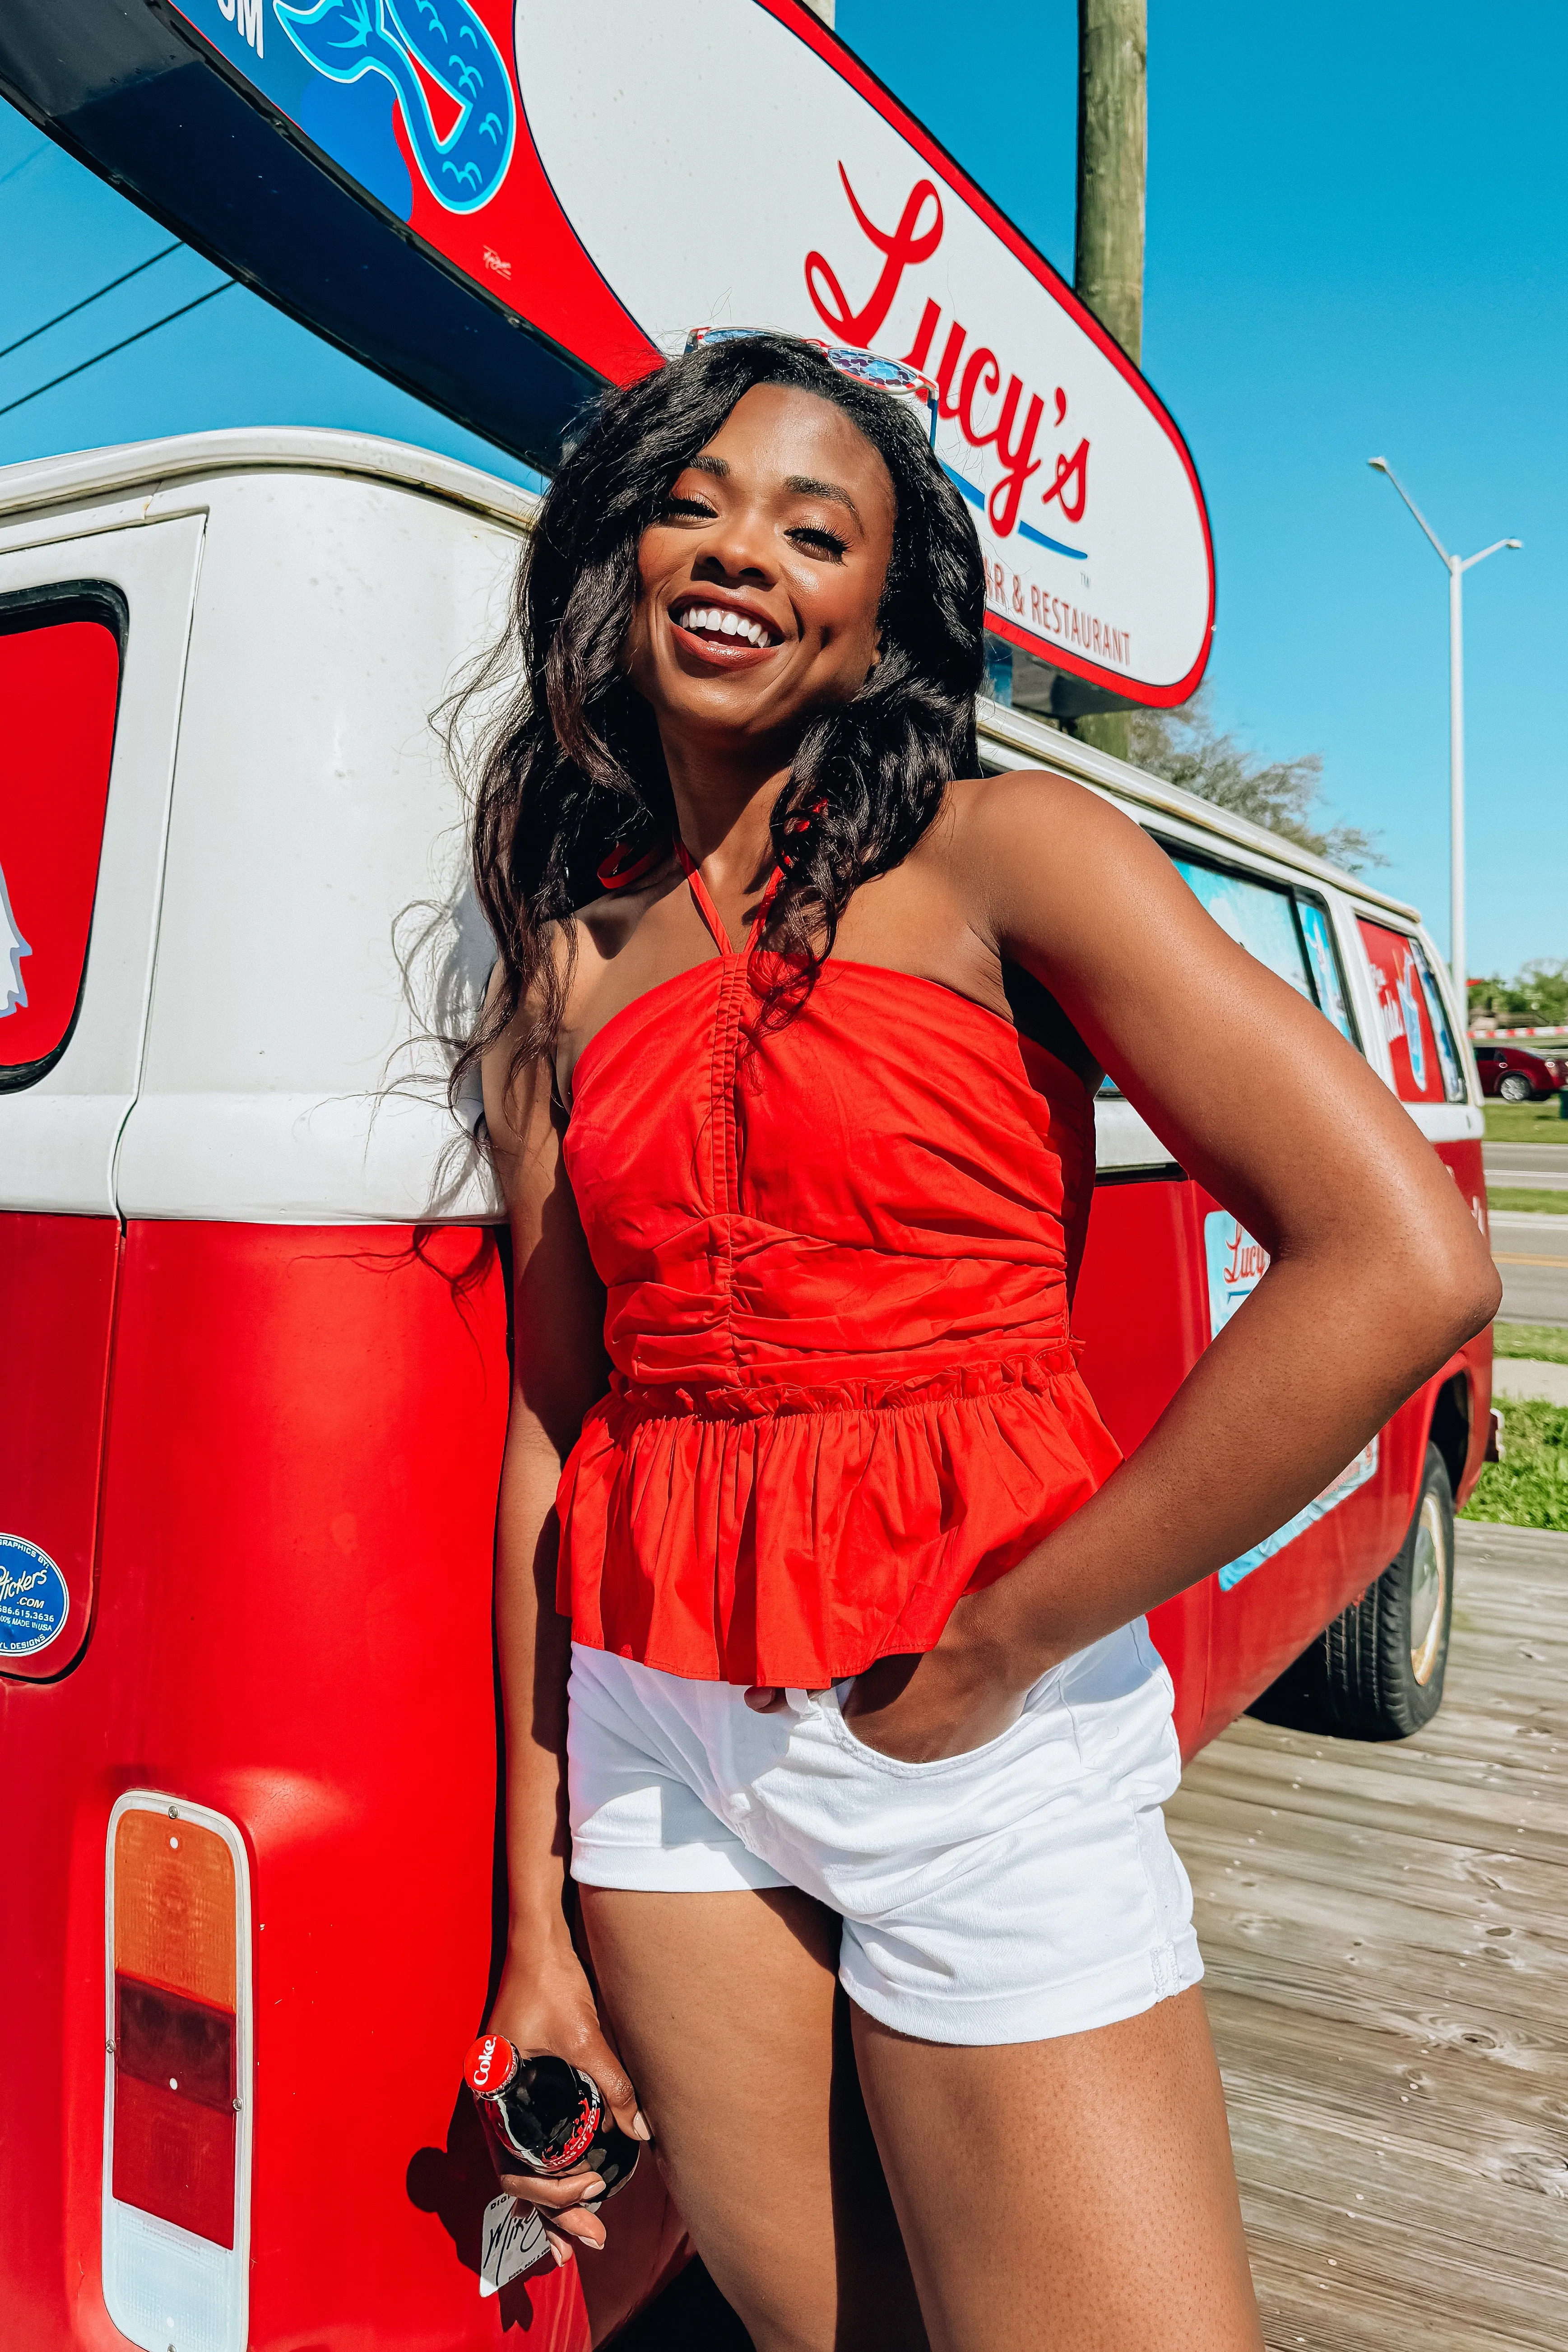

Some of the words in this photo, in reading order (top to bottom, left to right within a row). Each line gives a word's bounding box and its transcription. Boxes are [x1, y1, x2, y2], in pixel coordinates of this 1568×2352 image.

[805, 160, 1090, 538] Lucy's
[1012, 574, 1025, 617] &
[1031, 585, 1130, 667] RESTAURANT
[16, 1597, 45, 1609] .COM
[11, 1618, 30, 1628] MADE
[37, 1623, 52, 1631] USA
[10, 1633, 46, 1650] DESIGNS
